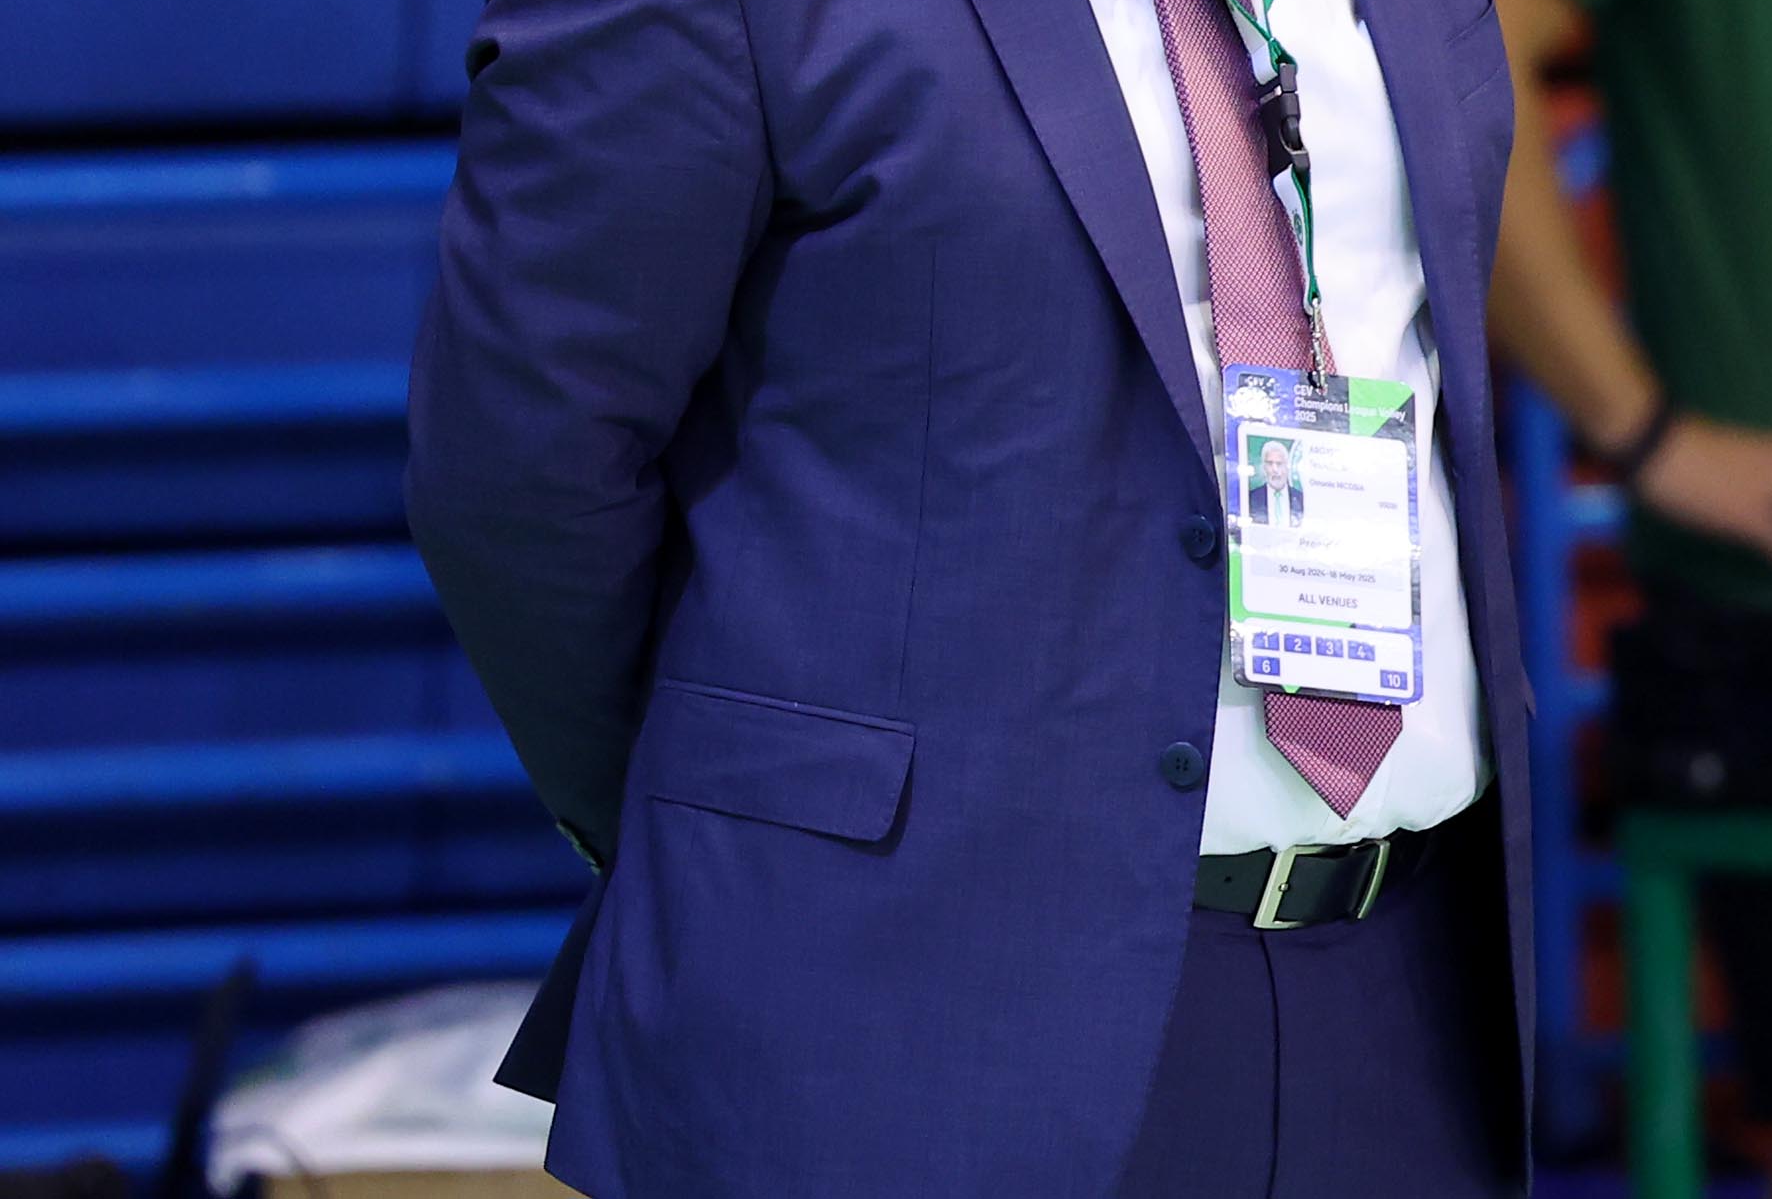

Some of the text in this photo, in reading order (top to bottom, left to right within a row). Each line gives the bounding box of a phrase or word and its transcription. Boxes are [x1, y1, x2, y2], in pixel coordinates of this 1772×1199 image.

[1293, 384, 1313, 397] CEV
[1293, 398, 1344, 414] Champions
[1294, 410, 1317, 422] 2025
[1298, 593, 1358, 609] ALL VENUES
[1262, 633, 1270, 648] 1
[1293, 638, 1303, 652] 2
[1325, 641, 1335, 655] 3
[1356, 645, 1367, 658] 4
[1261, 659, 1271, 674] 6
[1388, 673, 1401, 688] 10
